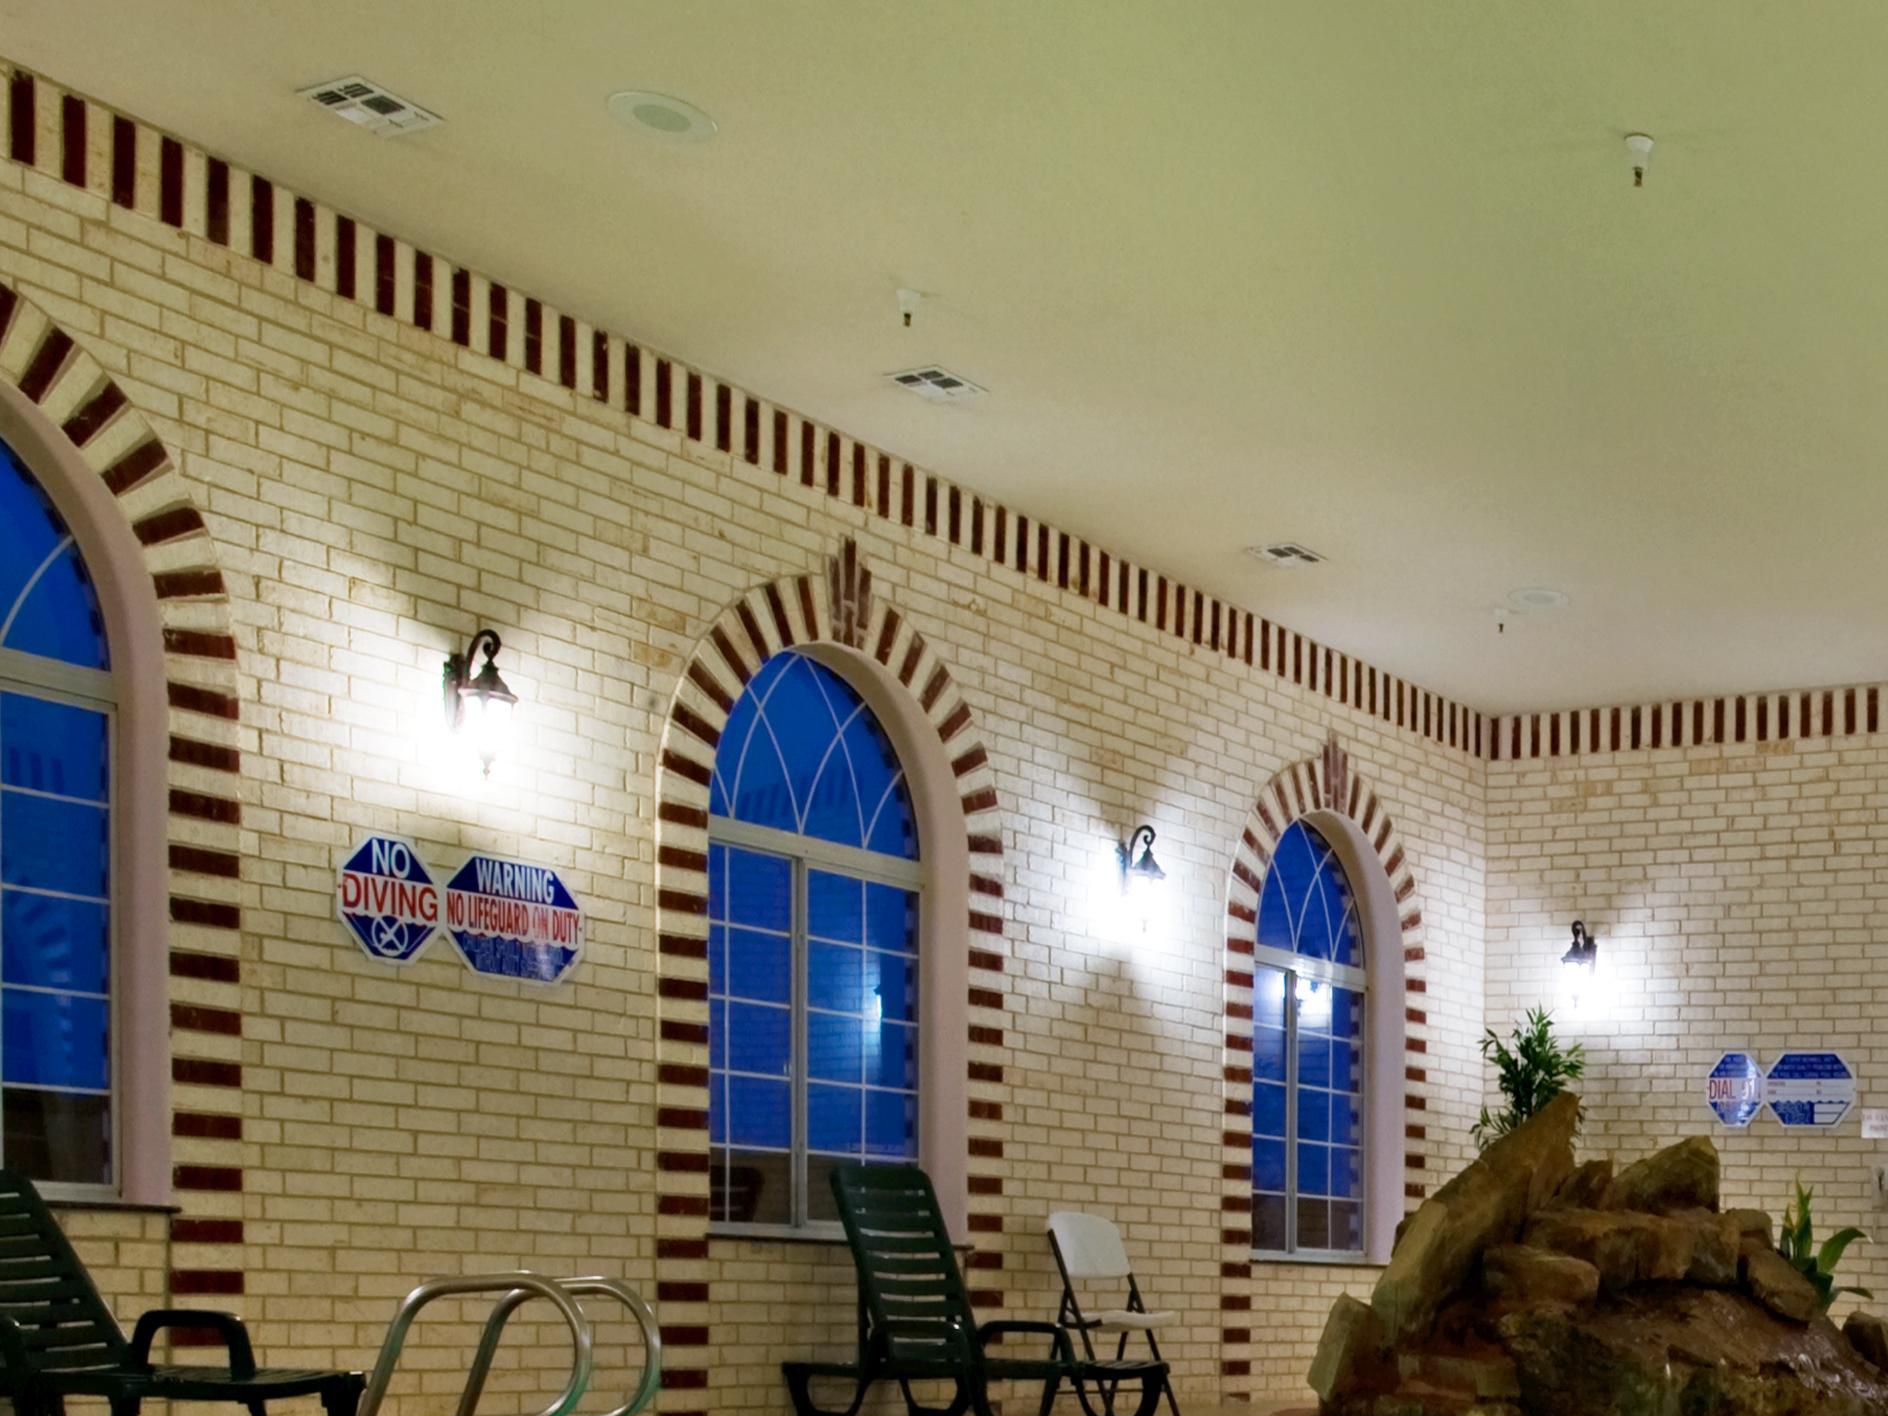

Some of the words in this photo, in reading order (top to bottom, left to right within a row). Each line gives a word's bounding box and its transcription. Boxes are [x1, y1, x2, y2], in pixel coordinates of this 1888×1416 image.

[371, 838, 411, 880] NO
[475, 857, 555, 905] WARNING
[342, 873, 438, 922] DIVING
[447, 891, 465, 926] NO
[468, 895, 528, 937] LIFEGUARD
[532, 908, 549, 941] ON
[552, 911, 580, 945] DUTY
[1709, 1079, 1736, 1099] DIAL
